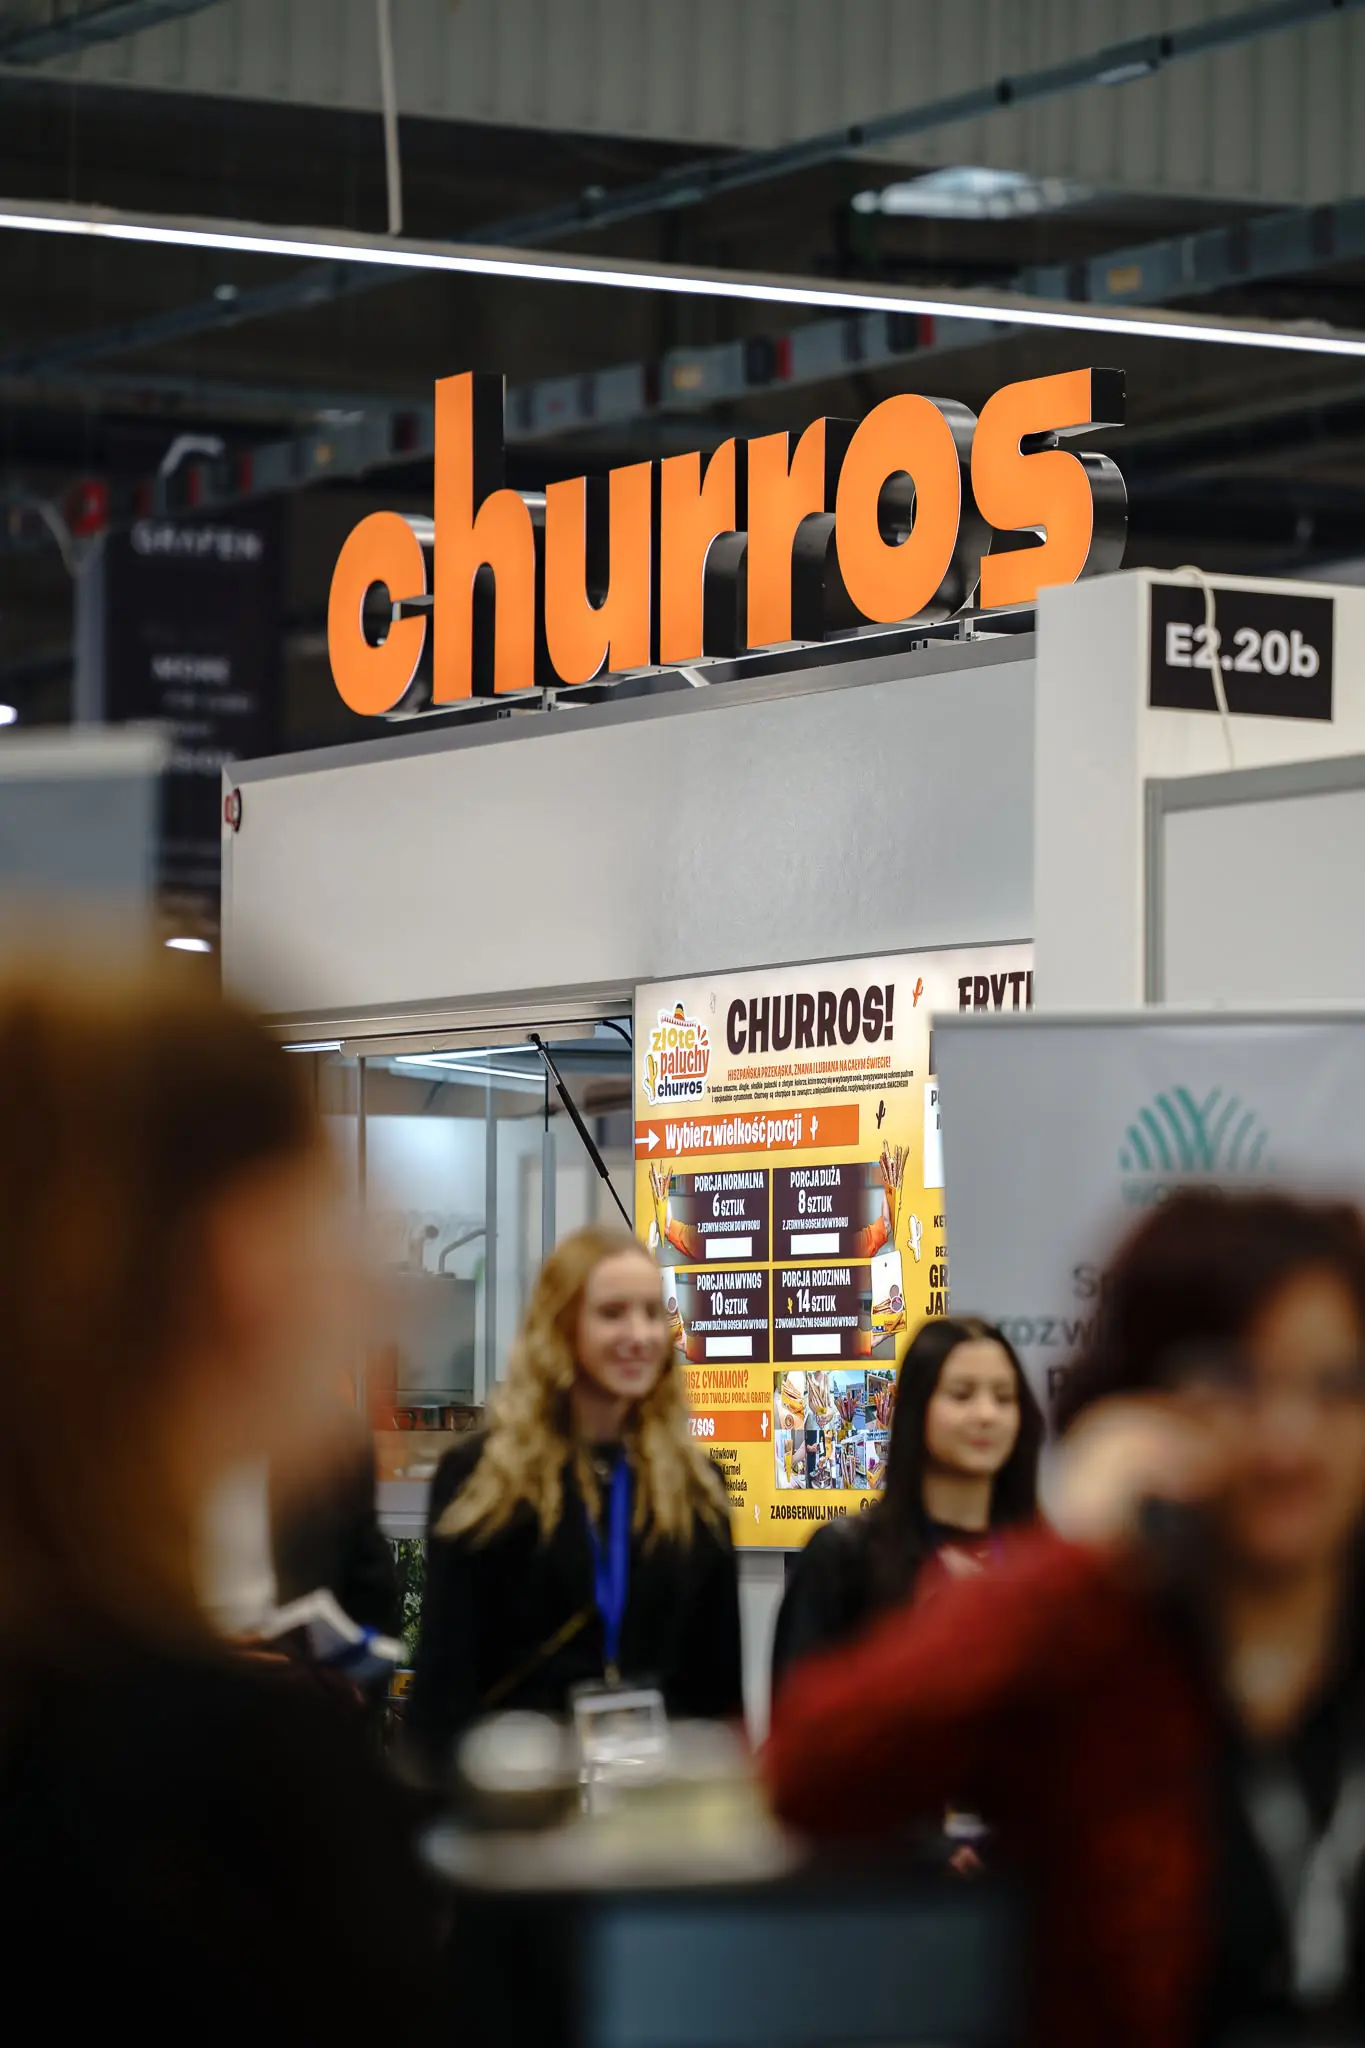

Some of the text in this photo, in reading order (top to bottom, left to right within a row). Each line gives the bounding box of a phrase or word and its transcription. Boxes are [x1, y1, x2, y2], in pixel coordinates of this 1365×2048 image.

[328, 368, 1096, 716] churros
[1165, 621, 1320, 678] E2.20b
[957, 971, 1034, 1014] FRYT
[727, 984, 895, 1055] CHURROS!
[661, 1044, 710, 1080] paluchy
[658, 1076, 702, 1097] churros
[665, 1113, 802, 1155] Wybierz wielkość porcji
[695, 1172, 764, 1192] PORCJA NORMALNA
[790, 1166, 841, 1188] PORCJA DUŻA
[713, 1193, 745, 1217] 6 SZTUK
[798, 1189, 832, 1214] 8 SZTUK
[697, 1274, 724, 1291] PORCJA
[782, 1268, 851, 1287] PORCJA RODZINNA
[710, 1291, 748, 1315] 10 SZTUK
[796, 1288, 836, 1313] 14 SZTUK
[702, 1369, 749, 1389] CYNAMON?
[710, 1392, 731, 1404] TWOJEJ
[770, 1504, 826, 1520] ZAOBSERWUJ
